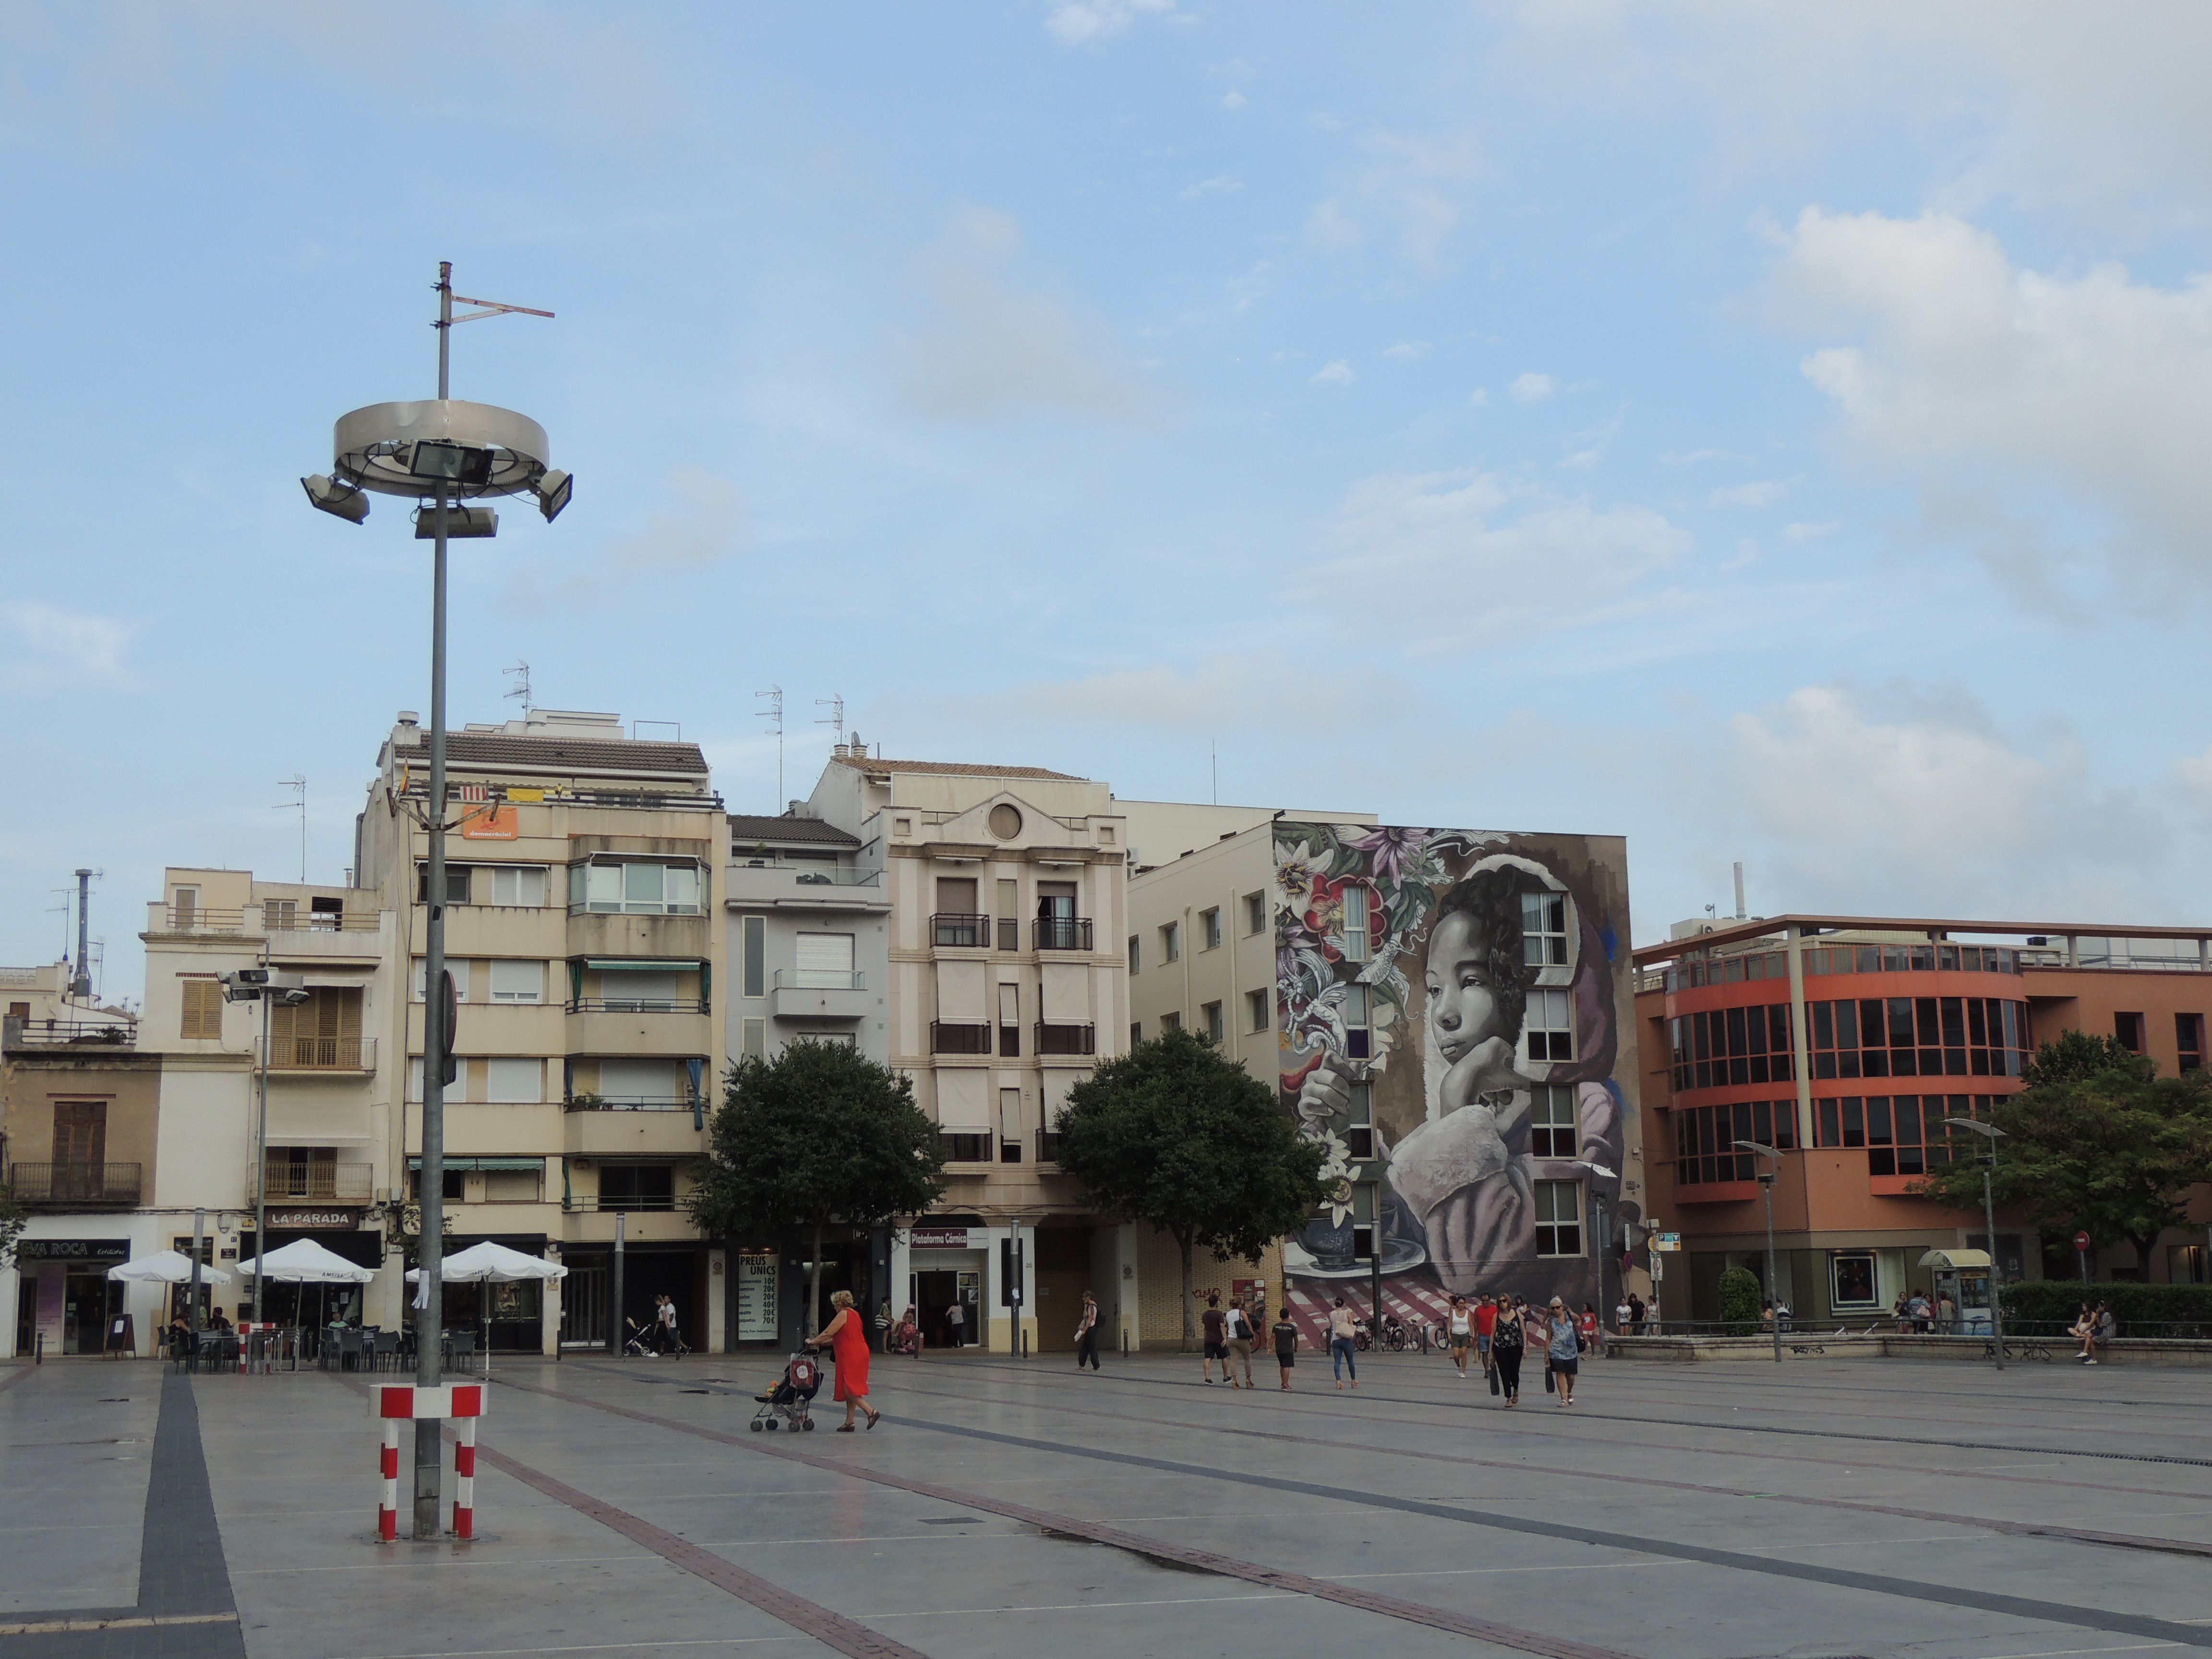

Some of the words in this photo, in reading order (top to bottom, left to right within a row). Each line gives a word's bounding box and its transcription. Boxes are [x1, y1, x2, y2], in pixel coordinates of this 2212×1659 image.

[272, 1213, 289, 1223] LA
[293, 1213, 349, 1224] PARADA
[912, 1232, 944, 1244] Plataforma
[945, 1232, 966, 1244] Cárnica
[51, 1242, 87, 1255] ROCA
[740, 1256, 766, 1265] PREUS
